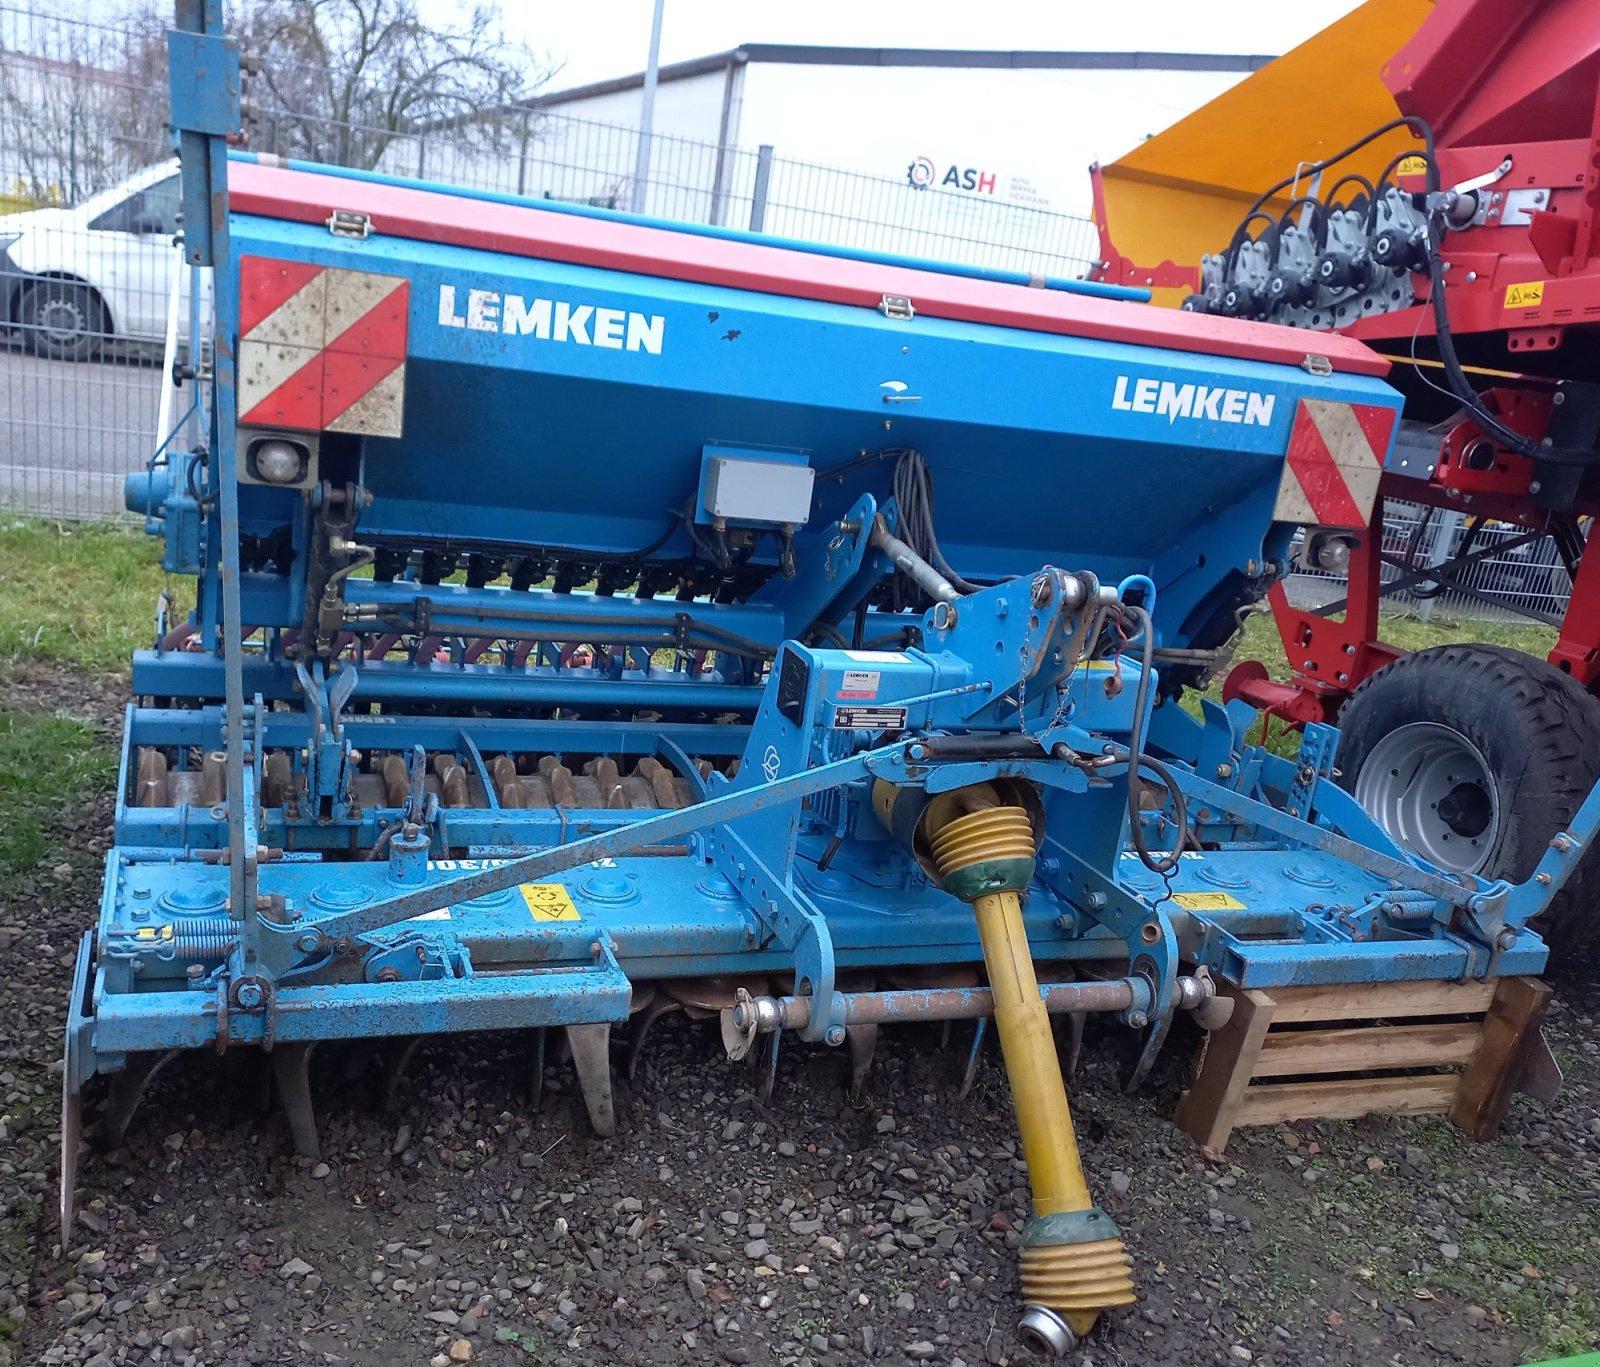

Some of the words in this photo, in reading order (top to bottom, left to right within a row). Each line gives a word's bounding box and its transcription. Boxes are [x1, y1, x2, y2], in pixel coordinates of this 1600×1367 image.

[942, 165, 996, 195] ASH
[438, 284, 665, 355] LEMKEN
[1111, 375, 1276, 427] LEMKEN
